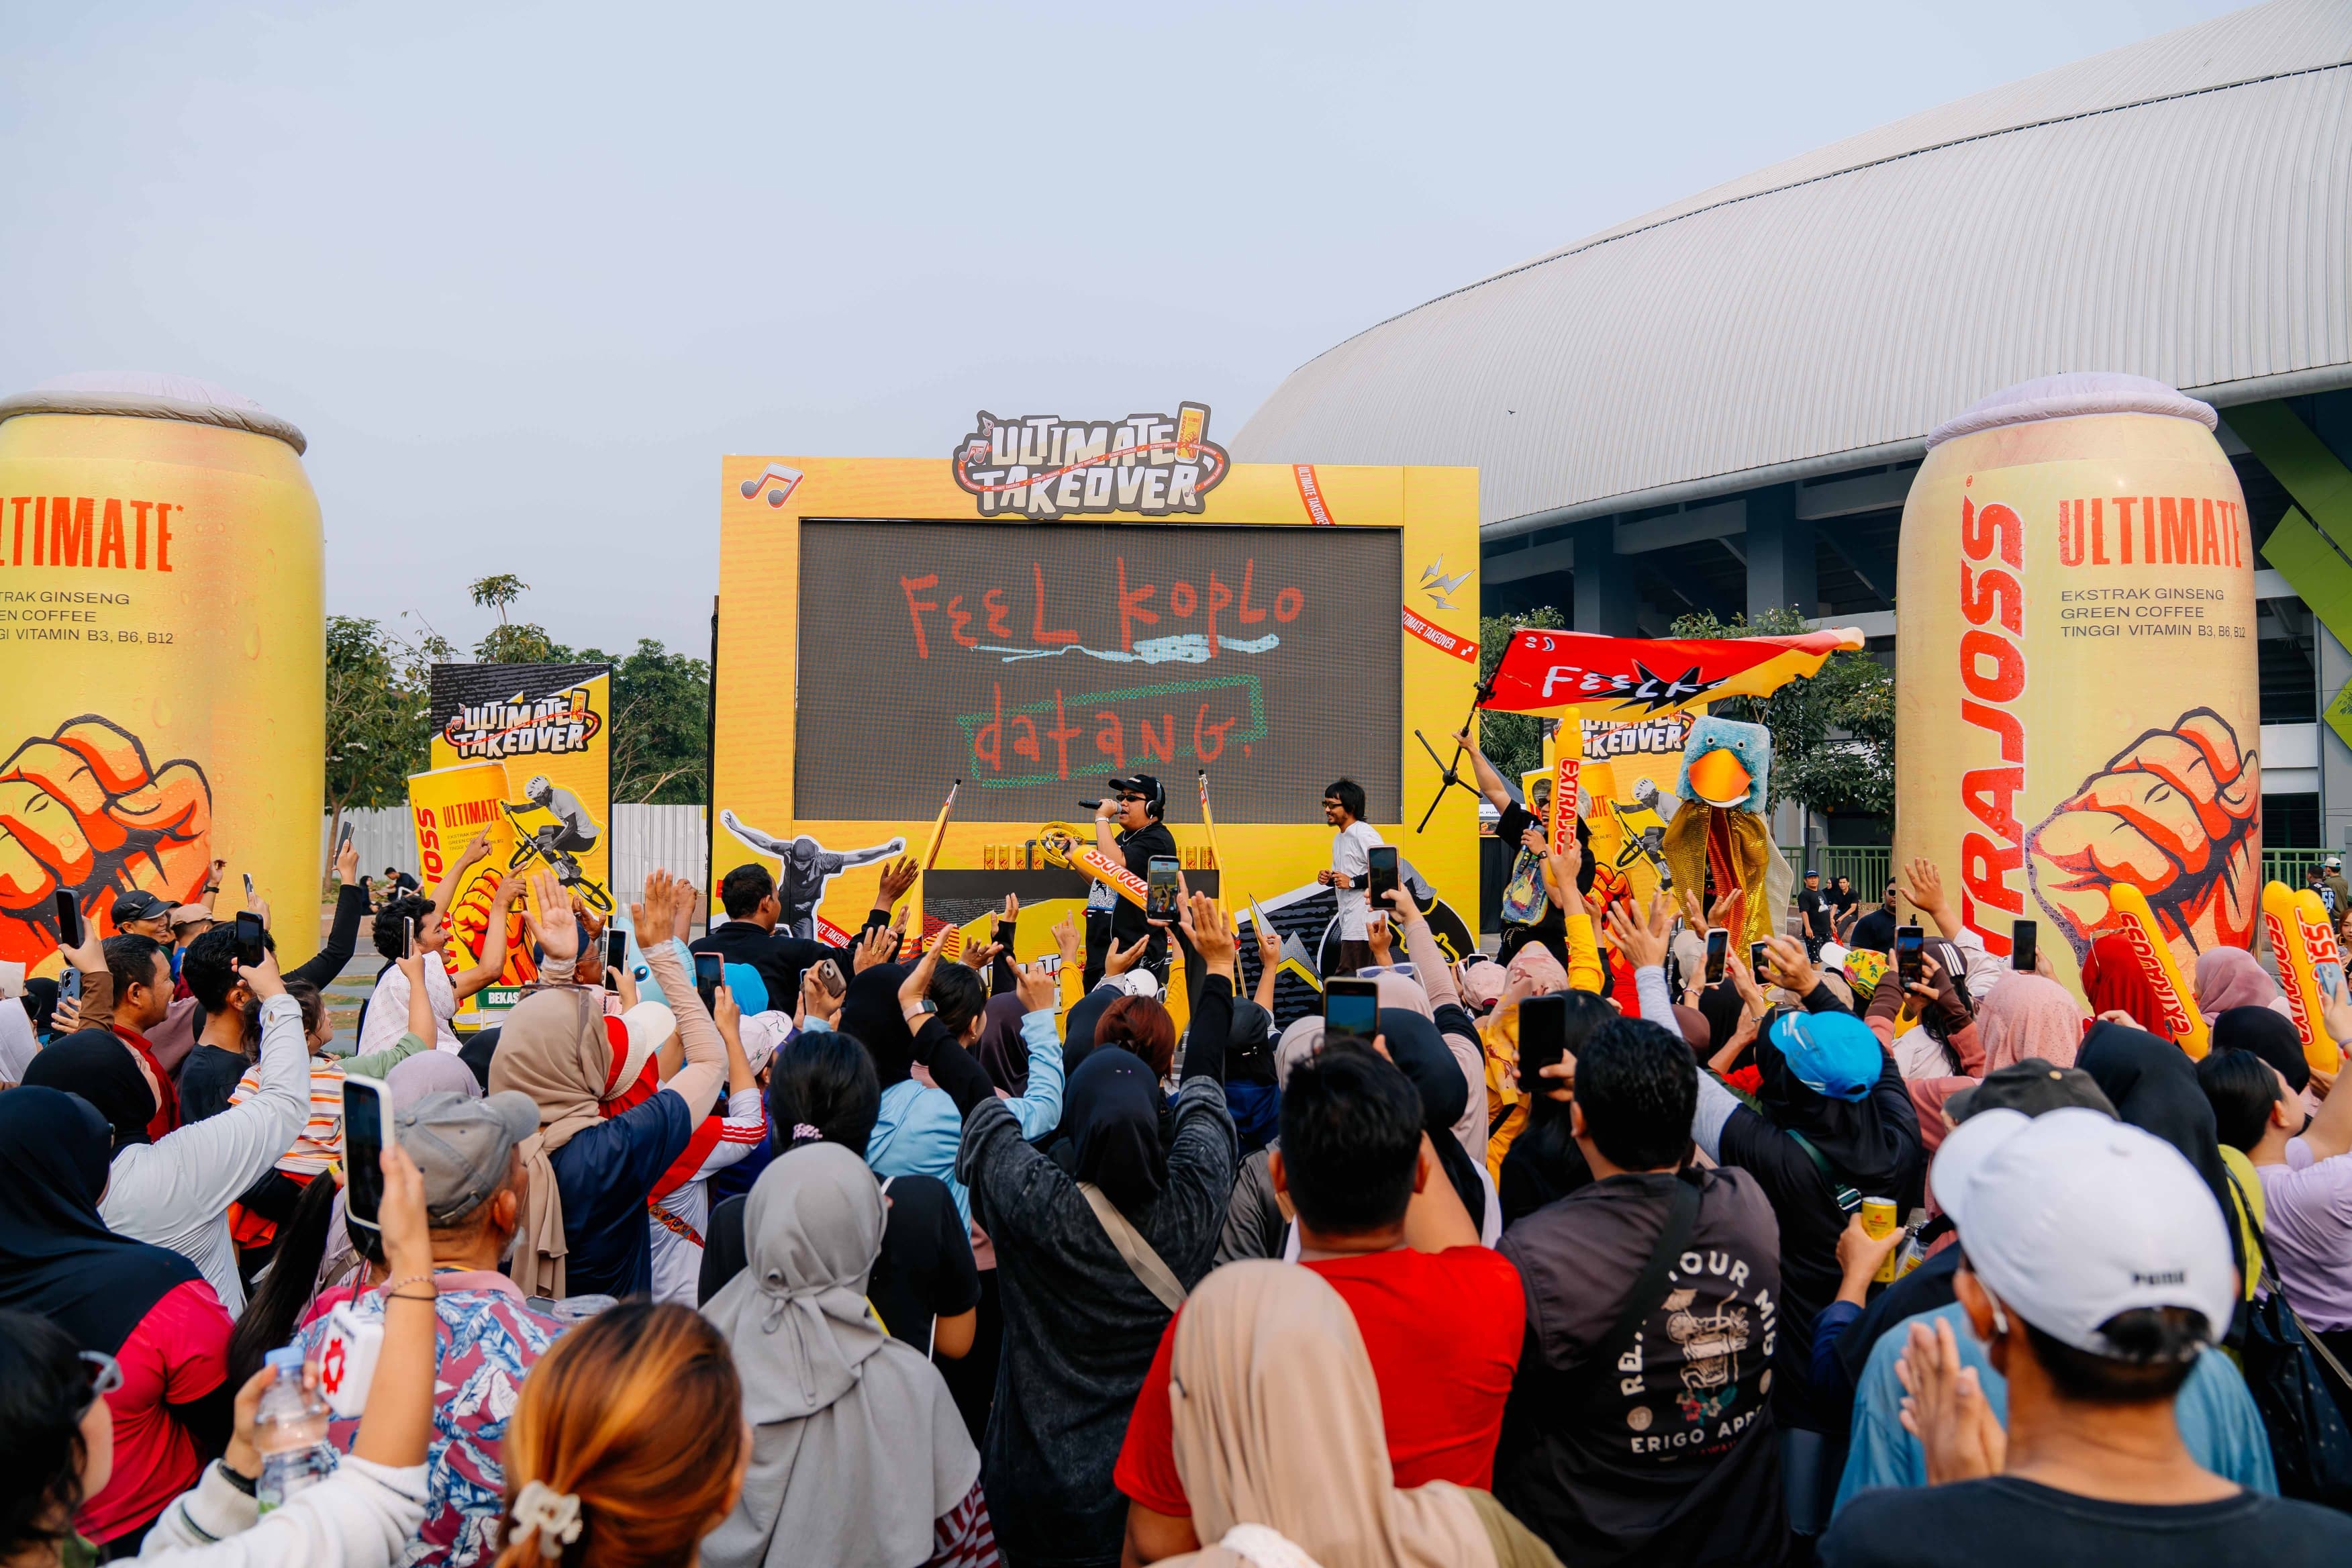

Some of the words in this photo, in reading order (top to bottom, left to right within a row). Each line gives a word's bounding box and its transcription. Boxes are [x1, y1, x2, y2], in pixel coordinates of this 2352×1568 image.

[991, 418, 1175, 466] ULTIMATE
[972, 465, 1199, 513] TAKEOVER
[1297, 467, 1317, 497] ULTIMATE
[1307, 496, 1330, 525] TAKEOVE
[2059, 497, 2242, 568] ULTIMATE
[40, 591, 130, 605] GINSENG
[2061, 588, 2151, 601] EKSTRAK
[2154, 588, 2224, 601] GINSENG
[21, 610, 97, 622] COFFEE
[2061, 607, 2130, 619] GREEN
[2135, 606, 2205, 618] COFFEE
[16, 629, 79, 640] VITAMIN
[87, 630, 113, 643] B3,
[118, 631, 142, 644] B6,
[147, 633, 174, 644] B12
[1422, 626, 1457, 650] TAKEOVER
[2061, 625, 2120, 637] TINGGI
[2128, 624, 2192, 636] VITAMIN
[2198, 625, 2216, 638] B3,
[2218, 626, 2233, 638] B6,
[2234, 626, 2246, 638] B12
[464, 697, 571, 731] ULTIMATE
[454, 724, 585, 757] TAKEOVER
[1582, 726, 1681, 757] AKEOVER
[443, 798, 500, 828] ULTIMATE
[488, 991, 520, 1004] BEKAS
[1669, 1251, 1750, 1289] OUR
[1630, 1428, 1704, 1453] ERIGO
